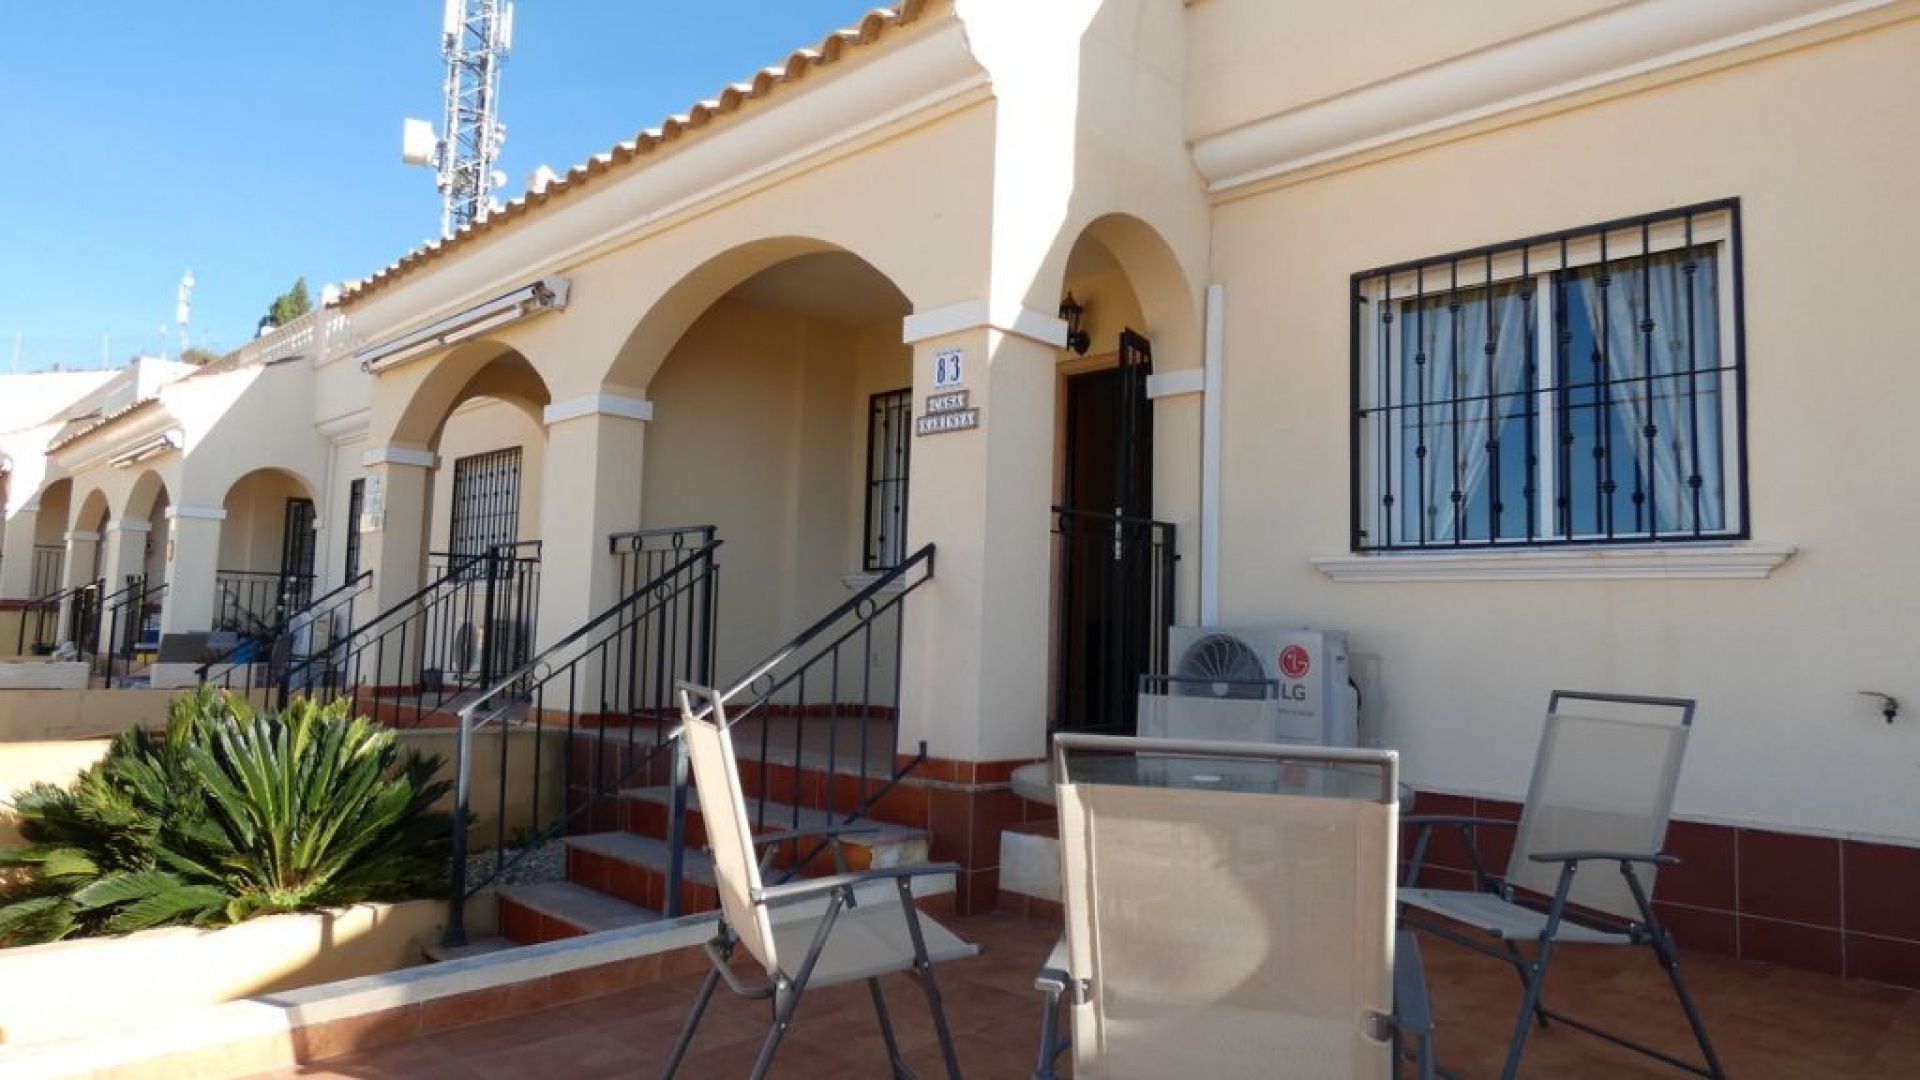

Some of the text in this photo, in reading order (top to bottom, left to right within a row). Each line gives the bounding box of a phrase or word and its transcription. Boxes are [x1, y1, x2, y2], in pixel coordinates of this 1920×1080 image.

[937, 355, 960, 383] 83
[932, 395, 961, 409] CASA
[1282, 683, 1306, 701] LG
